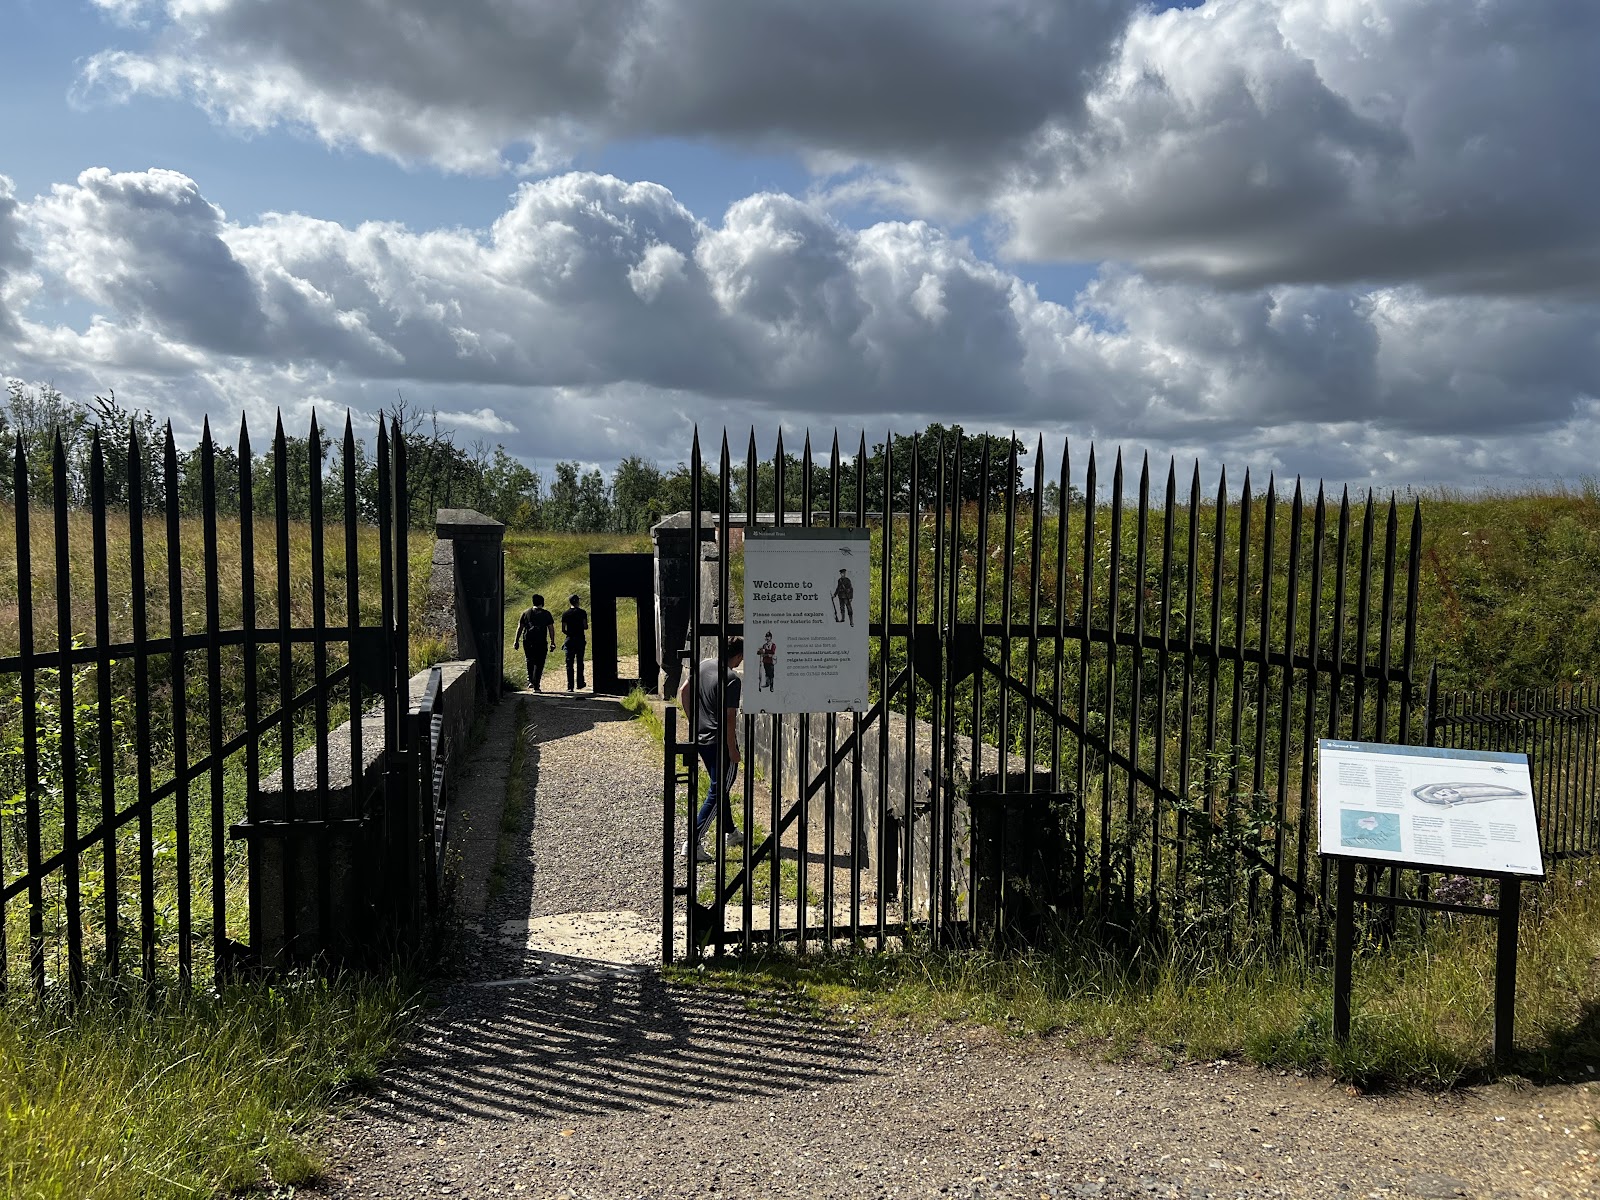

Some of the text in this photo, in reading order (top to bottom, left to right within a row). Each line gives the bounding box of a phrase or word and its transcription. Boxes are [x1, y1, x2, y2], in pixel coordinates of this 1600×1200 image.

[753, 580, 813, 589] Welcome to
[753, 592, 819, 603] Reigate Fort
